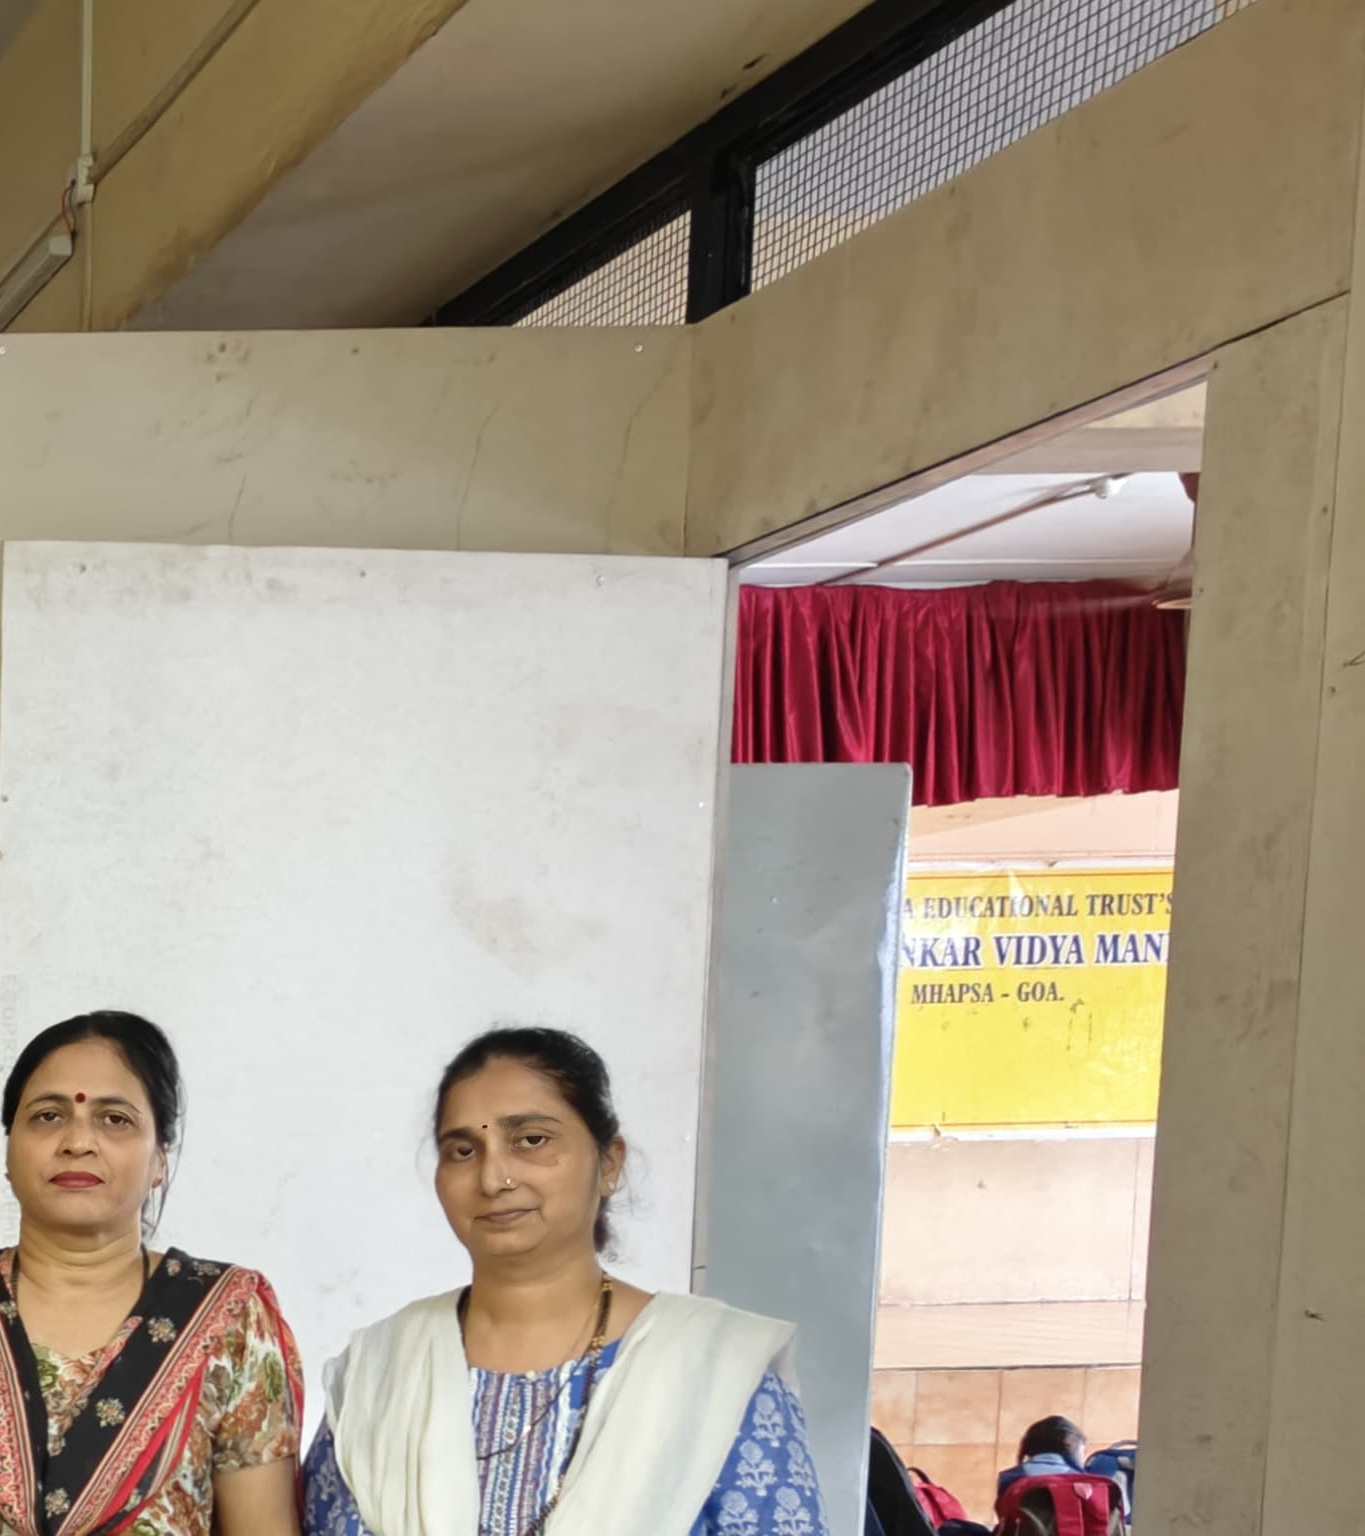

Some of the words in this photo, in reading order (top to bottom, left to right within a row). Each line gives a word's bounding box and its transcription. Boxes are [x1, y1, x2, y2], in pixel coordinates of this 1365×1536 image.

[924, 895, 1078, 919] EDUCATIONAL
[993, 934, 1085, 966] VIDYA
[1094, 932, 1169, 965] MAN
[911, 983, 994, 1005] MHAPSA
[1016, 981, 1065, 1003] GOA.
